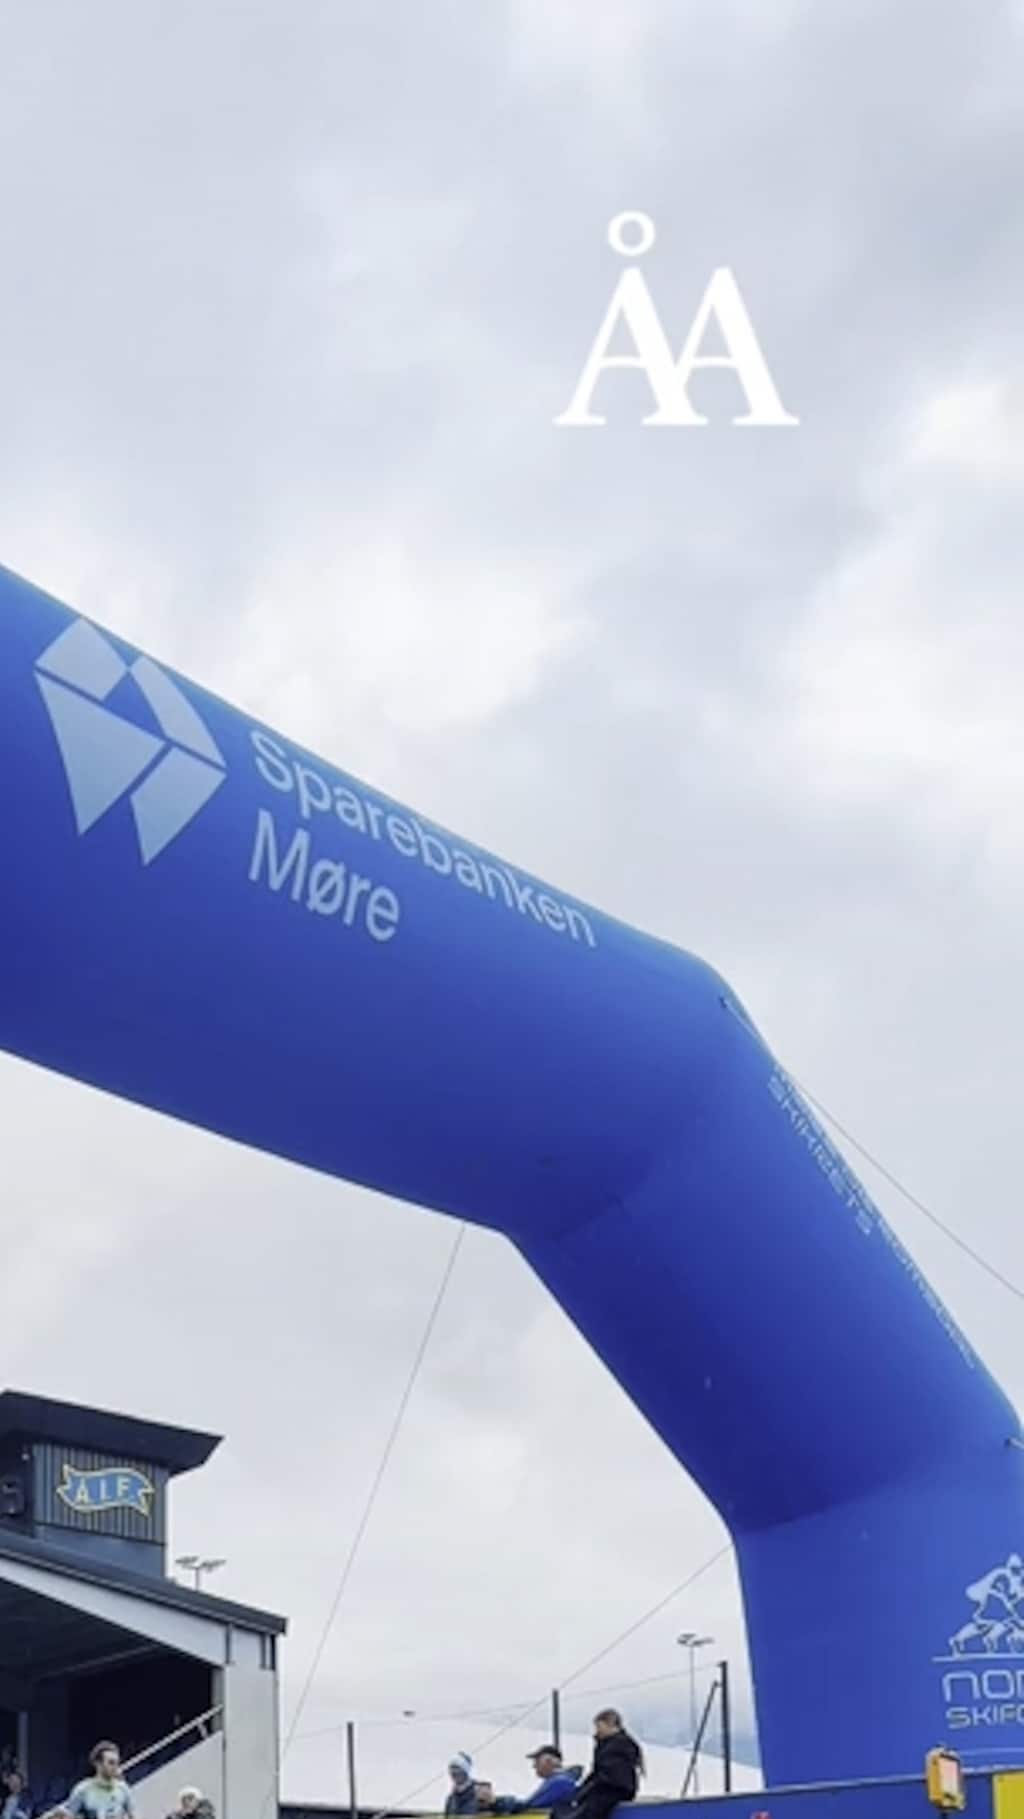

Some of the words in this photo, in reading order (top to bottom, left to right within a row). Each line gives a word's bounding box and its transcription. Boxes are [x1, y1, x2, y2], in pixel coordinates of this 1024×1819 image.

[248, 808, 401, 943] Møre
[250, 729, 597, 947] Sparebanken
[942, 1669, 1024, 1702] NO
